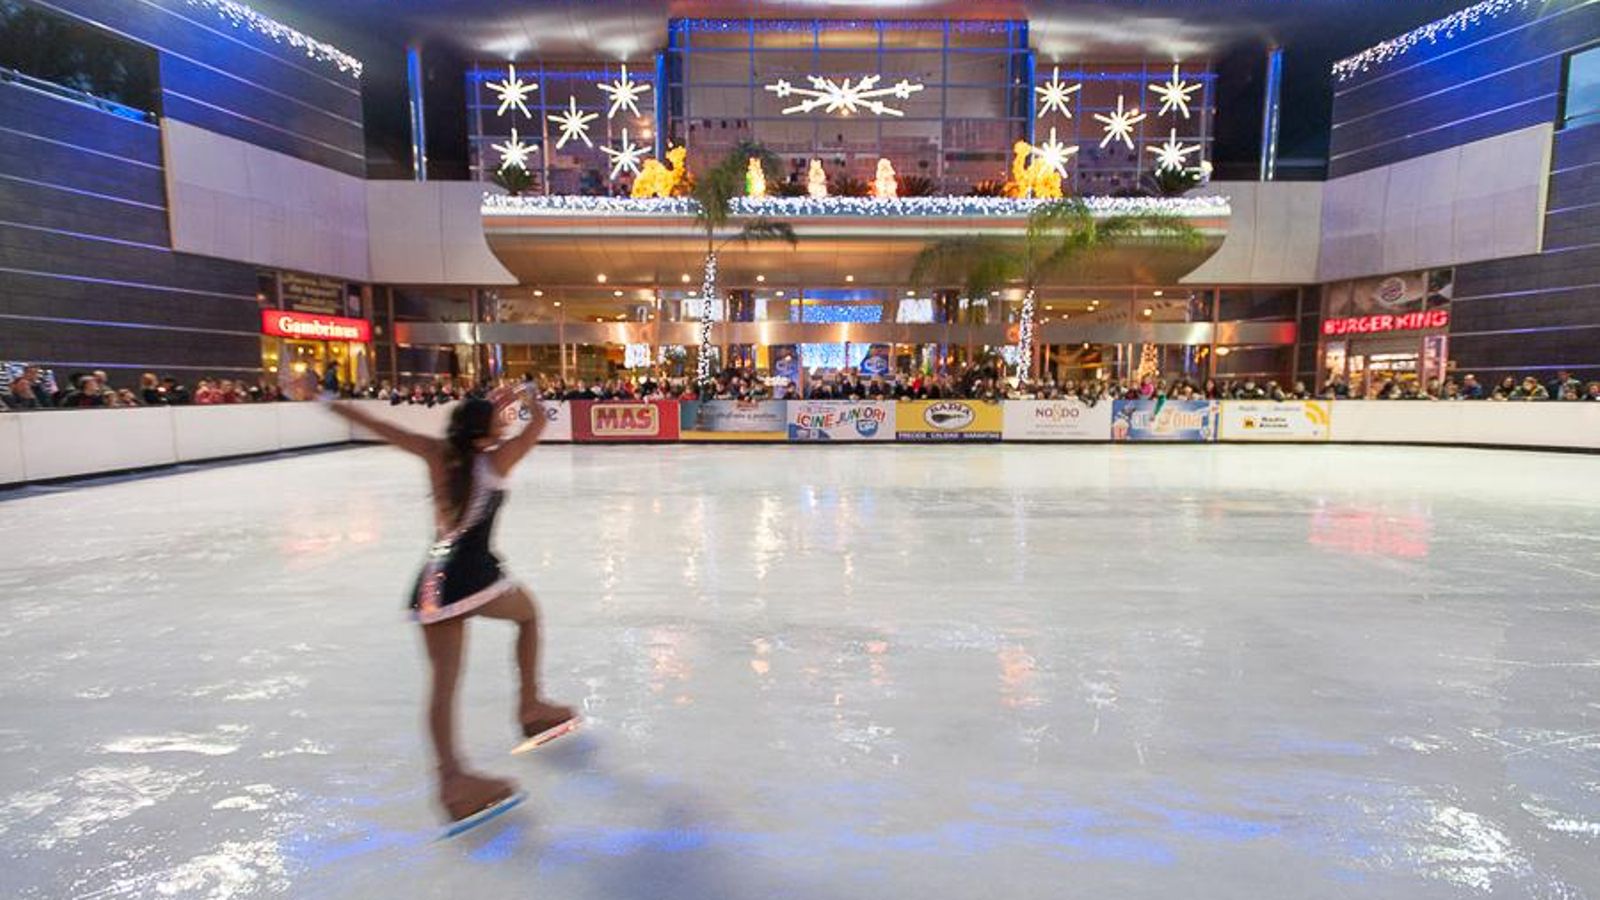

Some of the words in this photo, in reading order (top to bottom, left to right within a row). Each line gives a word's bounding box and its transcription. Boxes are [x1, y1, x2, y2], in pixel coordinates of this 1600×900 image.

[1322, 314, 1393, 334] BURGER
[1395, 309, 1448, 330] KING
[596, 407, 653, 430] MAS
